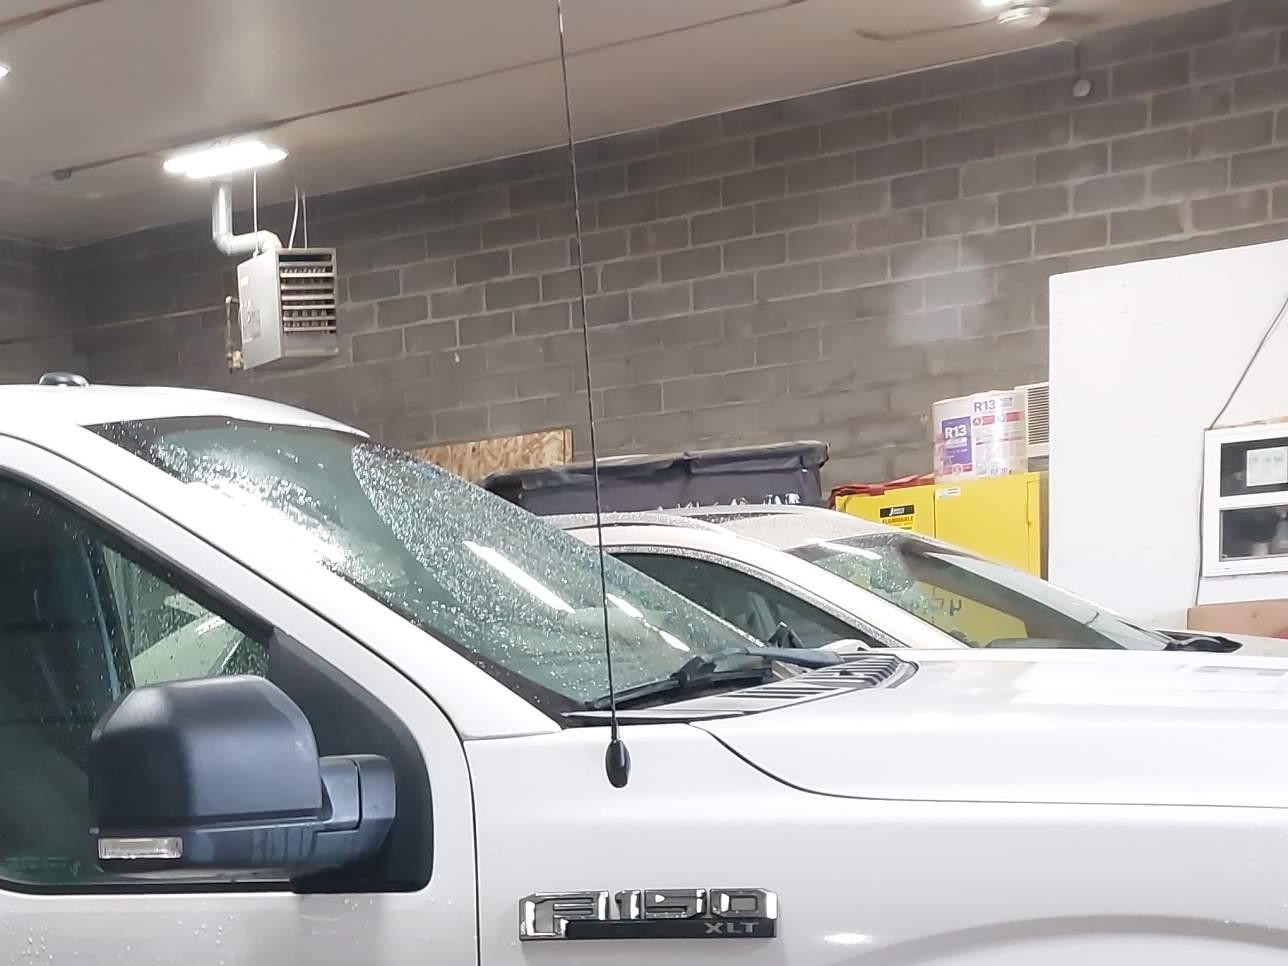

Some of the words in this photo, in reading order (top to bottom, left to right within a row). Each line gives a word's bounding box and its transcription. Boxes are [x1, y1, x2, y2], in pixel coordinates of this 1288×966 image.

[973, 399, 996, 413] R13
[944, 424, 967, 439] R13
[703, 921, 759, 935] XLT
